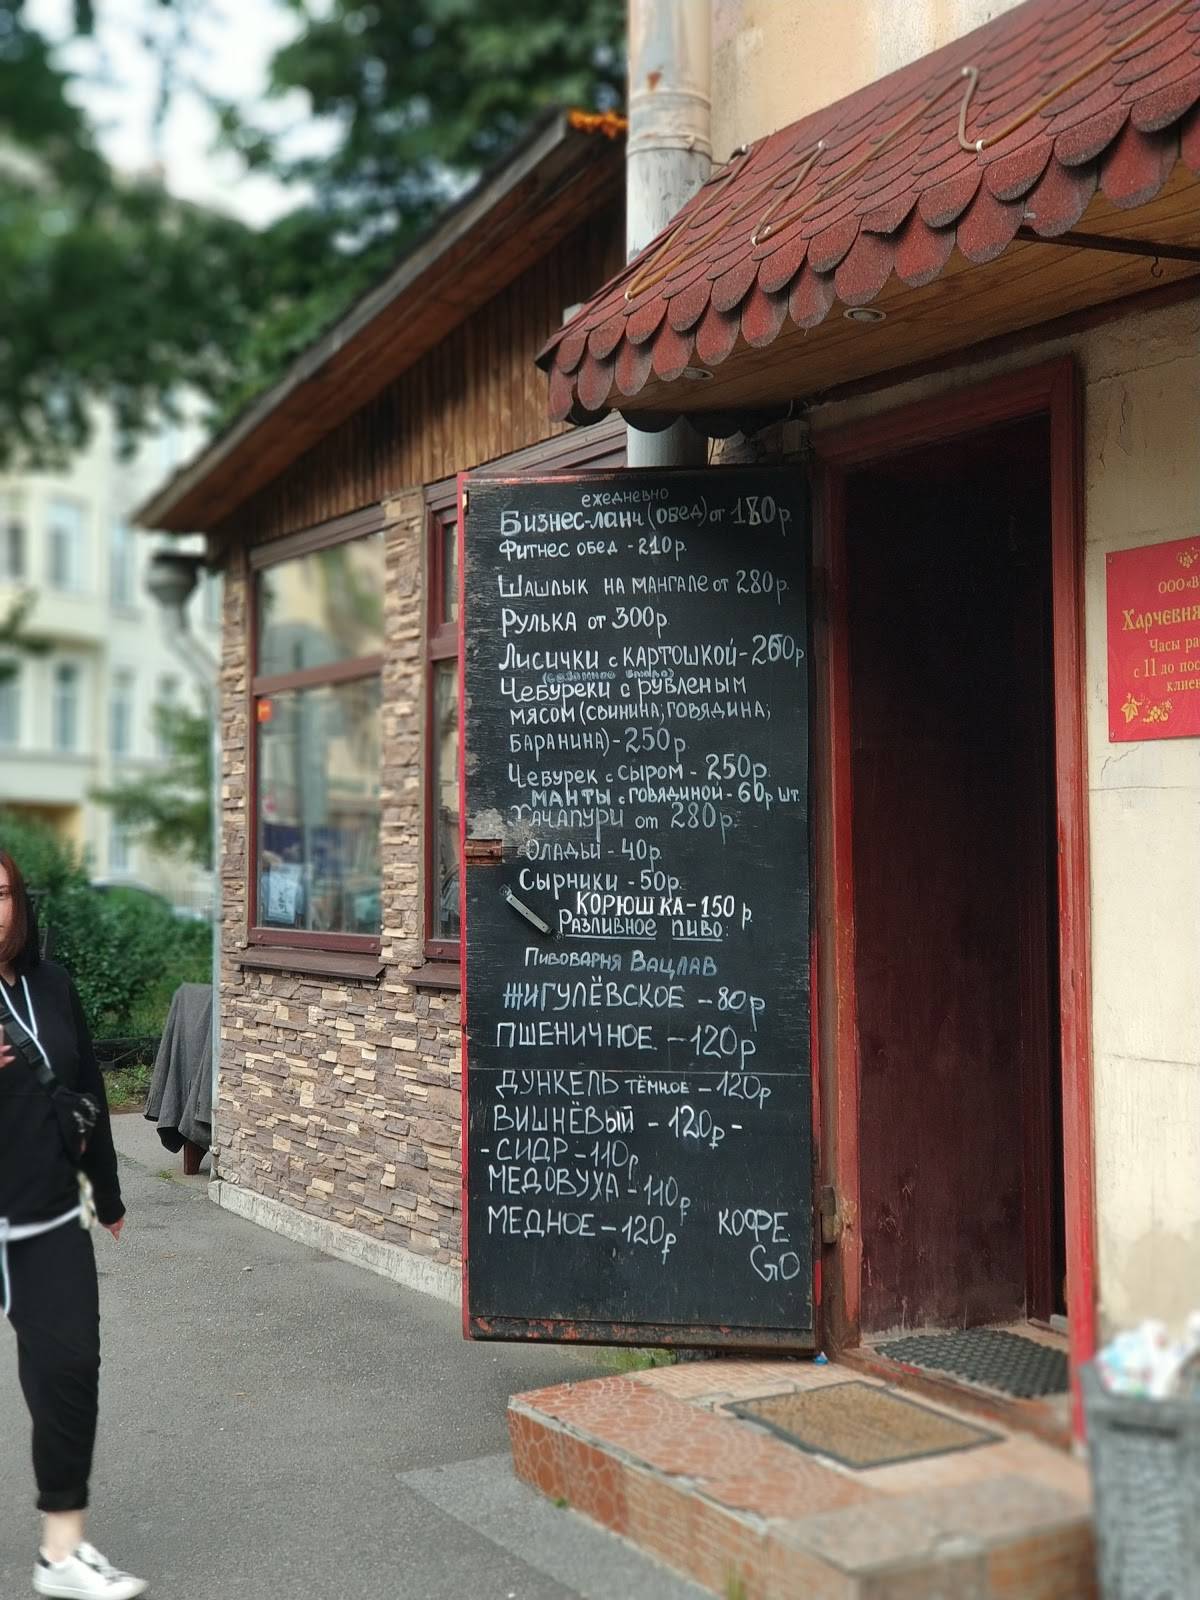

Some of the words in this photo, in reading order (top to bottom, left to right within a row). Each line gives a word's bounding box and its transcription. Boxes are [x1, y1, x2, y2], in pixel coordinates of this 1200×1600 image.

[581, 488, 669, 507] ежедневно
[500, 510, 644, 536] Бизнес-ланч
[709, 509, 725, 522] от
[499, 539, 571, 561] Фитнес
[577, 540, 618, 555] обед
[713, 577, 729, 592] от
[588, 614, 606, 629] от
[1149, 638, 1180, 653] Часы
[1185, 637, 1200, 654] ра
[1144, 657, 1157, 678] 11
[500, 677, 611, 711] Чебуреки
[508, 763, 598, 795] Чебурек
[635, 816, 658, 829] от
[519, 868, 618, 899] Сырники
[503, 976, 684, 1011] ЖИГУЛЁВСКОЕ
[496, 1021, 655, 1050] ПШЕНИЧНОЕ
[496, 1070, 619, 1098] ДУНКЕЛЬ
[496, 1138, 568, 1163] СИДР
[488, 1165, 619, 1202] МЕДОВУХА
[488, 1205, 595, 1238] МЕДНОЕ
[718, 1209, 790, 1243] КОФЕ
